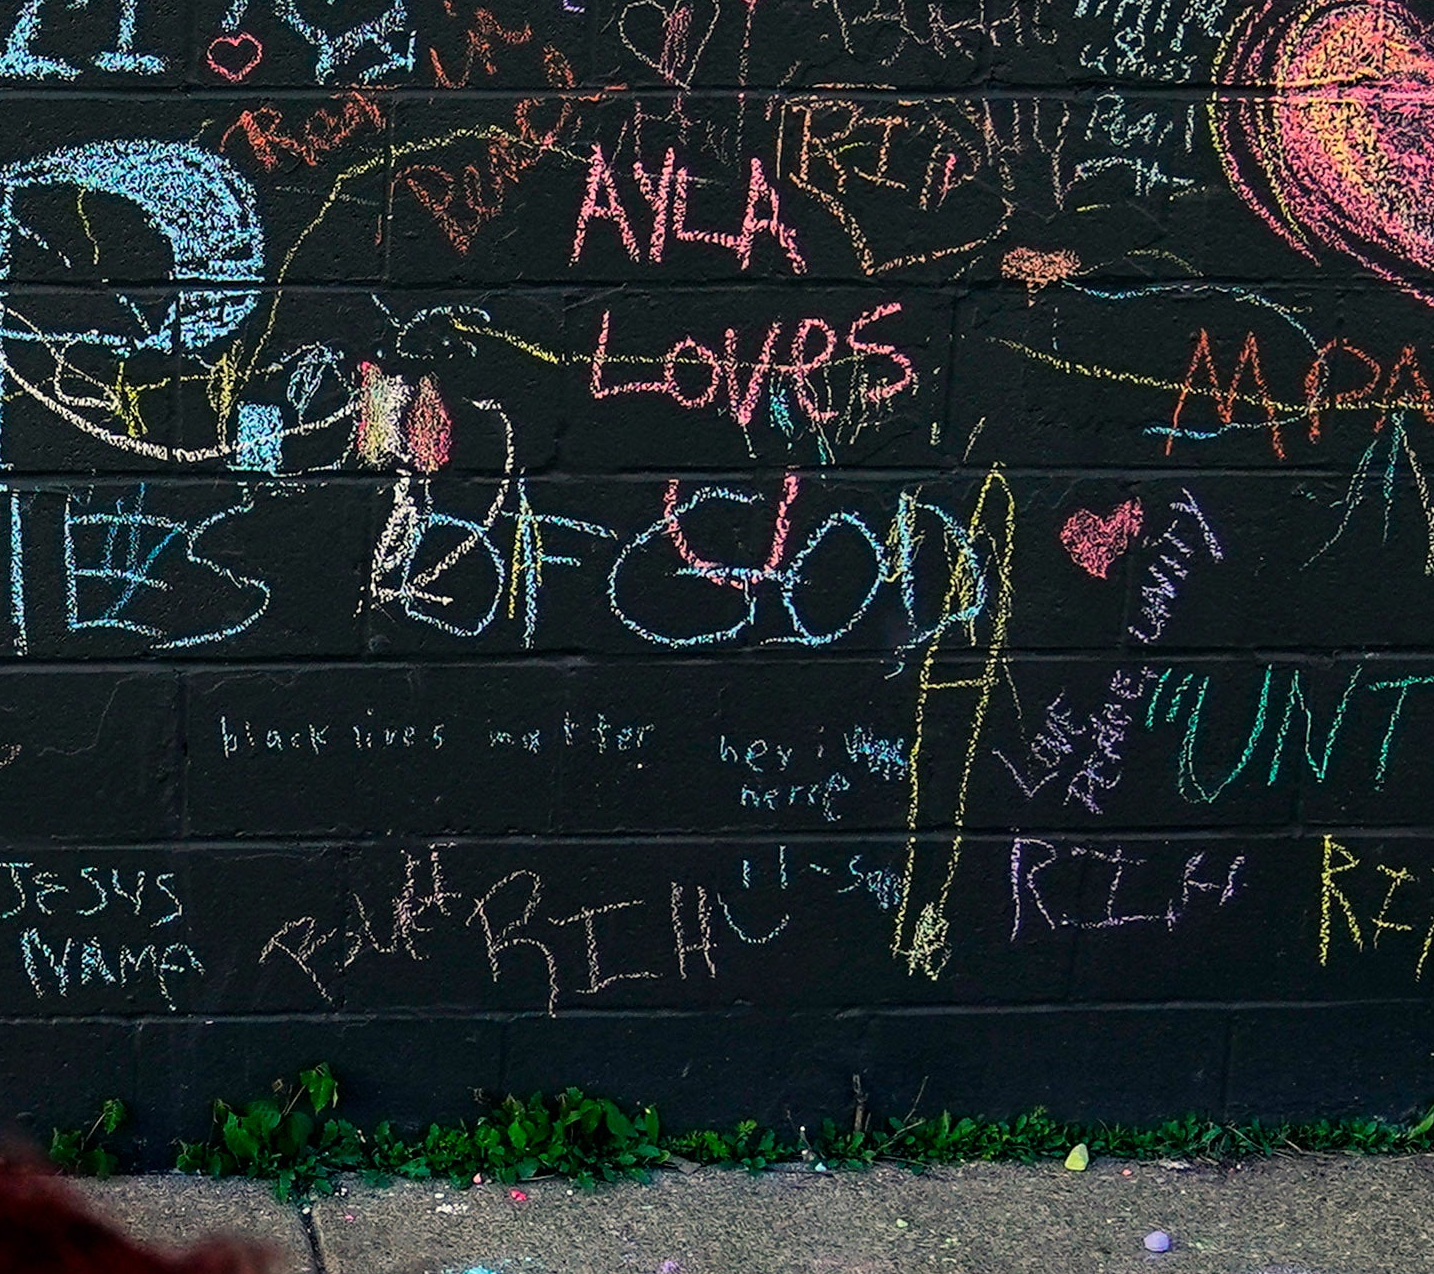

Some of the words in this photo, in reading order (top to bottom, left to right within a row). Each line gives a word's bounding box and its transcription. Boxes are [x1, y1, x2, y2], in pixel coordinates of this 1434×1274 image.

[567, 140, 809, 275] AYLA
[220, 715, 329, 758] black
[352, 708, 445, 750] lives
[489, 713, 654, 754] matter
